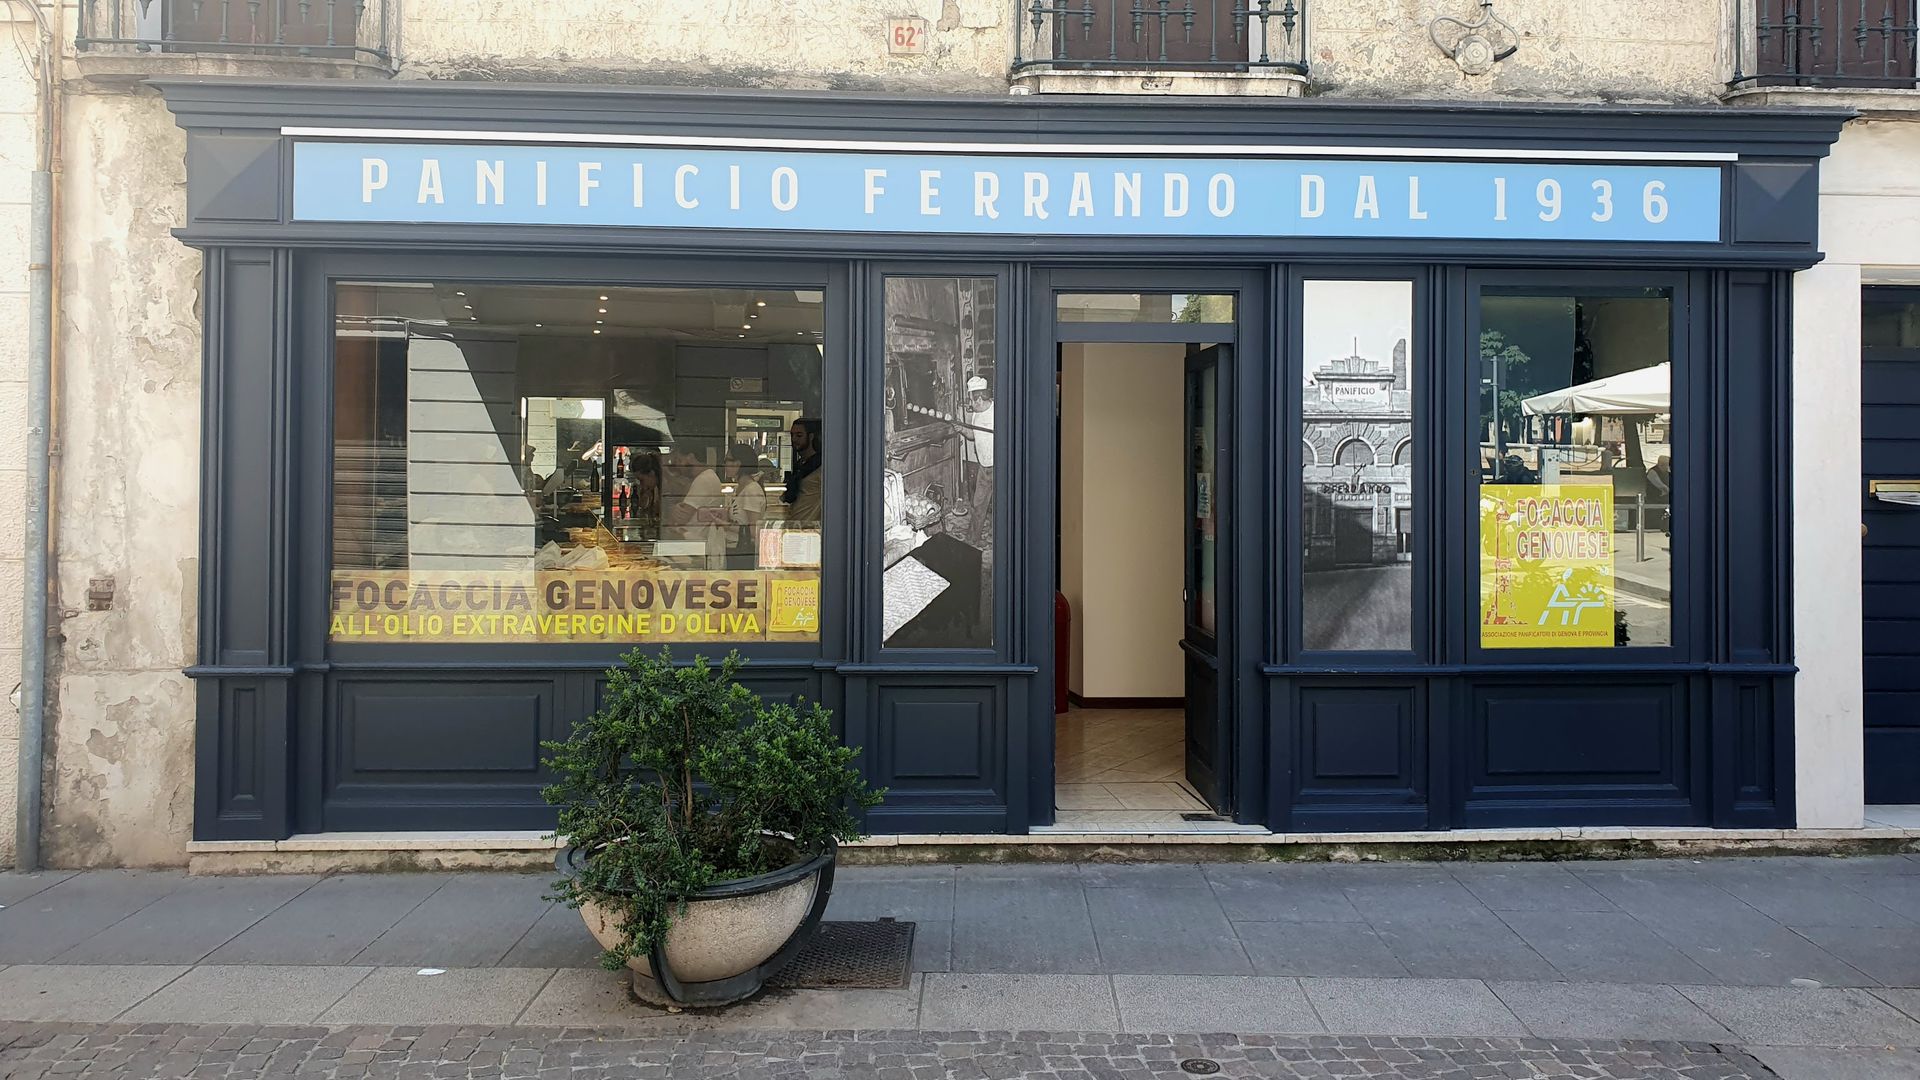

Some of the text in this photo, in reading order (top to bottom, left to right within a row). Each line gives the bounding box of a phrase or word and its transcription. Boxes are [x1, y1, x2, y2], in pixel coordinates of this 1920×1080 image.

[361, 157, 1669, 223] PANIFICIO FERRANDO DAL 1936
[1335, 386, 1376, 396] PANIFICIO
[1516, 498, 1604, 529] FOCACCIA
[1516, 530, 1610, 560] GENOVESE
[331, 579, 758, 612] FOCACCIA GENOVESE
[784, 597, 816, 607] GENOVESE
[329, 613, 760, 636] ALL'OLIO EXTRAVERGINE D'OLIVA
